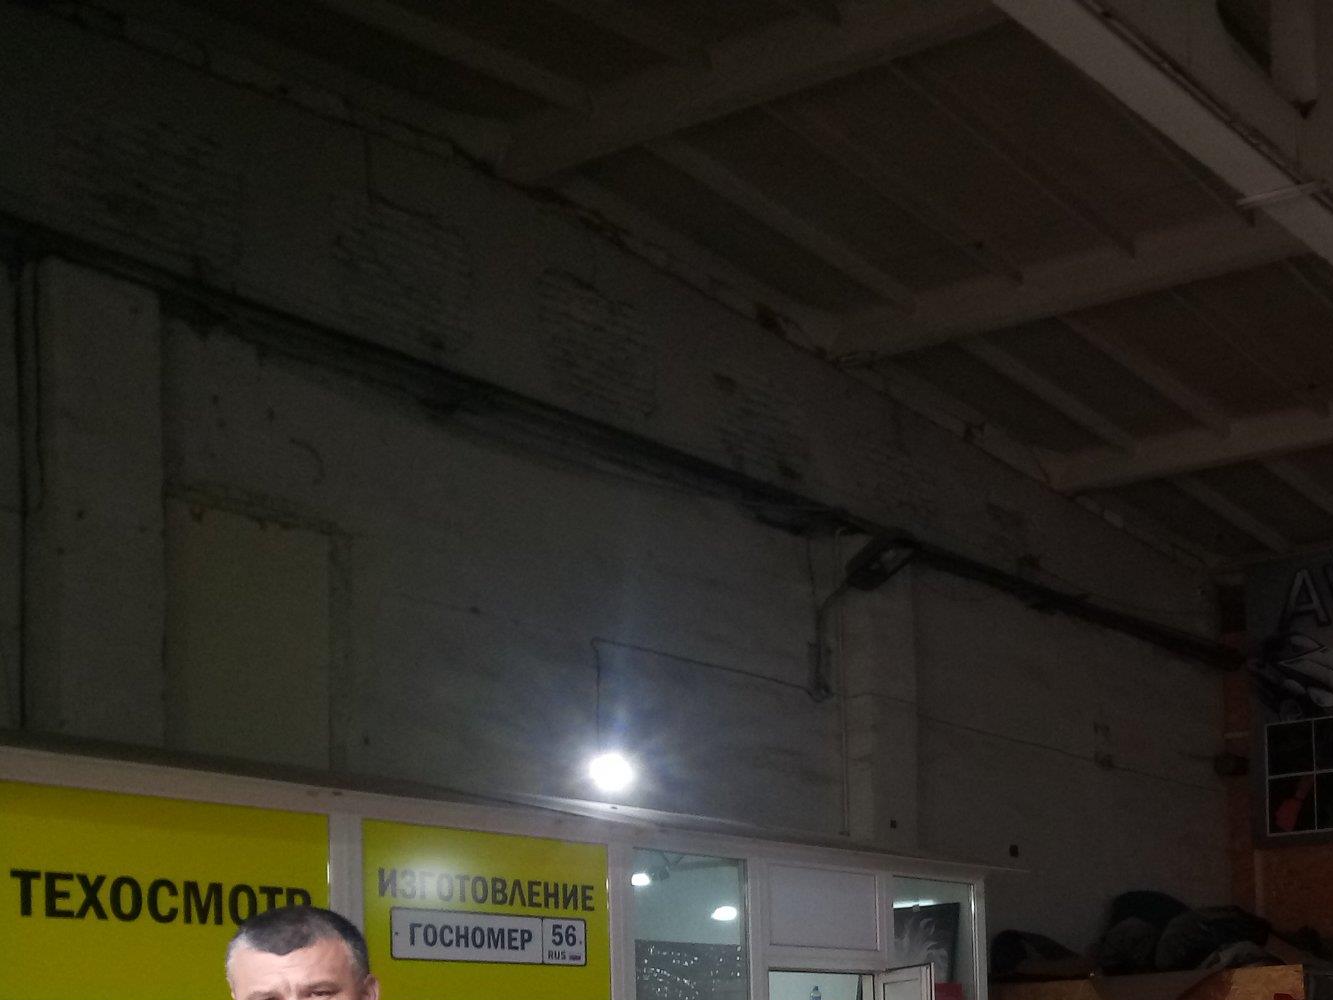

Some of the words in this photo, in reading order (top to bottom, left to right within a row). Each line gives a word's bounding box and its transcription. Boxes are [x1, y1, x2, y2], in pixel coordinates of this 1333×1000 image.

[378, 866, 595, 912] ИЗГОТОВЛЕНИЕ
[409, 922, 533, 951] ГОСНОМЕР
[551, 924, 577, 947] 56
[547, 950, 567, 960] RUS
